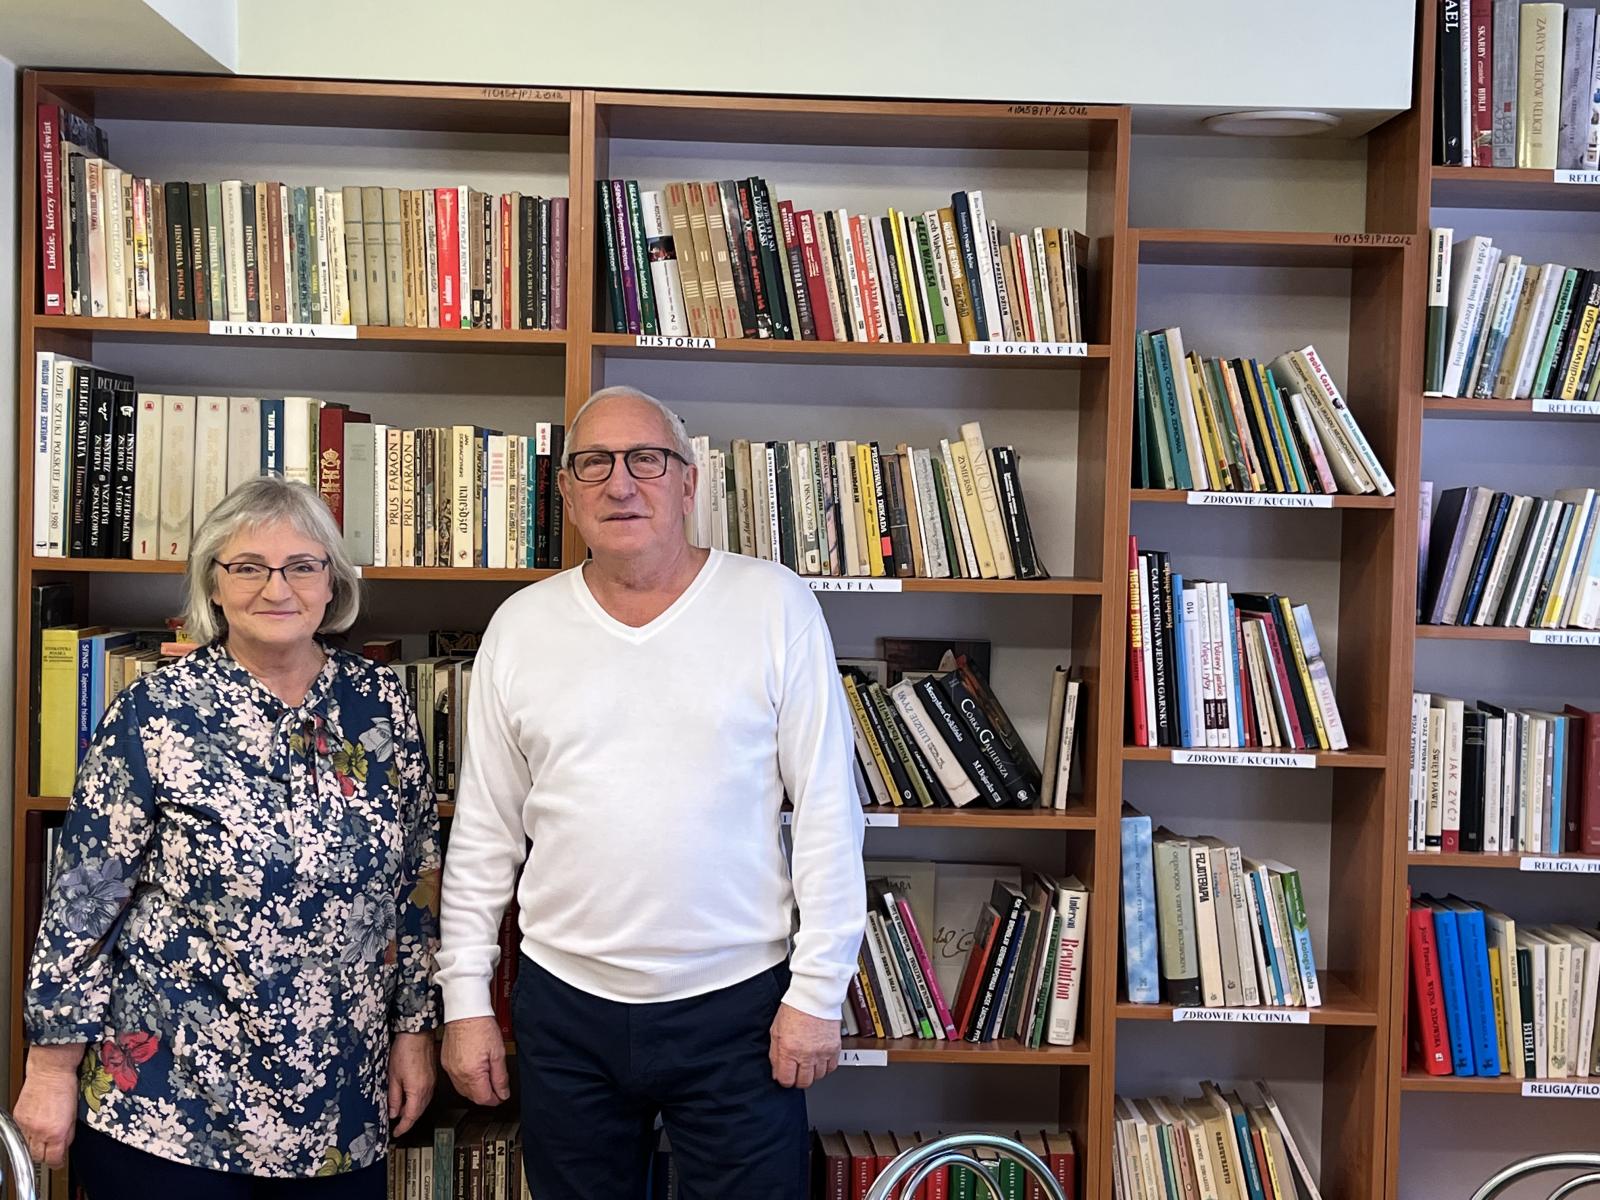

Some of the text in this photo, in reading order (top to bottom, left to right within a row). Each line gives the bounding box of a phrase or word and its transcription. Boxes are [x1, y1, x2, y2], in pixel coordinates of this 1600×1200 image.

[1477, 26, 1485, 58] SKARBY
[1531, 18, 1546, 135] ZARYS DZIEJÓW RELIGII
[43, 121, 57, 270] Ludzie, którzy zmienili świat
[193, 228, 202, 269] HISTORIA
[209, 225, 219, 268] HISTORIA
[756, 219, 768, 246] POLSKI
[916, 221, 928, 246] LECH
[928, 214, 943, 260] Lech Wałęsa
[942, 221, 957, 249] ROBERT
[174, 224, 186, 300] HISTORIA POLSKI
[245, 225, 256, 301] HISTORIA POLSKI
[620, 248, 631, 271] historii
[947, 250, 961, 280] BIEDROŃ
[796, 289, 809, 323] SZYFRÓW
[1467, 274, 1481, 301] dawnej
[1554, 279, 1572, 325] Katechizm
[225, 326, 316, 337] HISTORIA
[873, 307, 883, 328] LECH
[640, 336, 712, 348] HISTORIA
[984, 345, 1085, 355] BIOGRAFIA
[1565, 345, 1585, 394] modlitwa
[1580, 309, 1595, 334] czyn
[41, 360, 49, 385] HISTORII
[1306, 351, 1335, 397] Paolo Cozza
[41, 388, 49, 412] SEKRETY
[1157, 340, 1183, 454] HIGIENA OCHRONA ZDROWIA
[1548, 404, 1594, 413] RELIGIA
[50, 367, 64, 529] DZIEJE SZTUKI POLSKIEJ 1890 1980
[74, 376, 89, 524] RELIGIE ŚWIATA Huston Smith
[93, 434, 102, 471] TADEUSZ
[102, 433, 112, 473] ZIELIŃSKI
[117, 434, 125, 472] TADEUSZ
[125, 433, 135, 472] ZIELIŃSKI
[115, 485, 123, 517] GRECJA
[389, 442, 399, 525] PRUS FARAON
[403, 444, 413, 527] PRUS FARAON
[817, 479, 825, 511] renesans
[871, 446, 887, 533] PRZERWANA DEKADA
[972, 451, 997, 513] CHOPIN
[1203, 495, 1314, 506] ZDROWIE KUCHNIA
[90, 483, 100, 546] STAROŻYTNOŚĆ
[101, 483, 110, 525] BAJECZNA
[121, 485, 132, 542] NIEPODLEGŁA
[141, 540, 147, 554] 1
[170, 542, 178, 555] 2
[809, 581, 874, 591] GRAFIA
[1163, 562, 1173, 629] Kuchnia chińska
[1186, 601, 1194, 615] 110
[1151, 568, 1167, 728] CAŁA KUCHNIA JEDNYM GARNKU
[1545, 635, 1590, 644] RELIGIA
[80, 644, 90, 731] SFINKS Tajemnice historii
[1202, 672, 1213, 691] ryby
[1214, 641, 1225, 696] Potrawy jarskie
[960, 698, 1009, 779] CÓRKA GALILEUSZA
[1186, 753, 1298, 766] ZDROWIE KUCHNIA
[1430, 748, 1440, 810] ŚWIĘTY PAWEŁ
[1448, 757, 1457, 780] JAK
[1195, 852, 1209, 903] FIZJOTERAPIA
[1229, 851, 1245, 909] Fizjoterapia
[1534, 861, 1579, 871] RELIGIA
[1014, 898, 1023, 908] ROK
[1056, 896, 1081, 1001] Anderson Revolution
[1176, 928, 1186, 974] VADEMECUM
[1300, 937, 1314, 989] Ekologia ciała
[984, 991, 994, 1006] JACEK
[1419, 927, 1440, 1048] Józef Flawiusz WOJNA ŻYDOWSKA
[1182, 1011, 1292, 1022] ZDROWIE KUCHNIA
[1522, 1022, 1534, 1062] BIBLII
[1530, 1084, 1600, 1096] RELIGIA/FILO
[487, 1145, 494, 1154] 1
[498, 1147, 504, 1155] 2
[1216, 1131, 1232, 1184] CIASTKARSTWO
